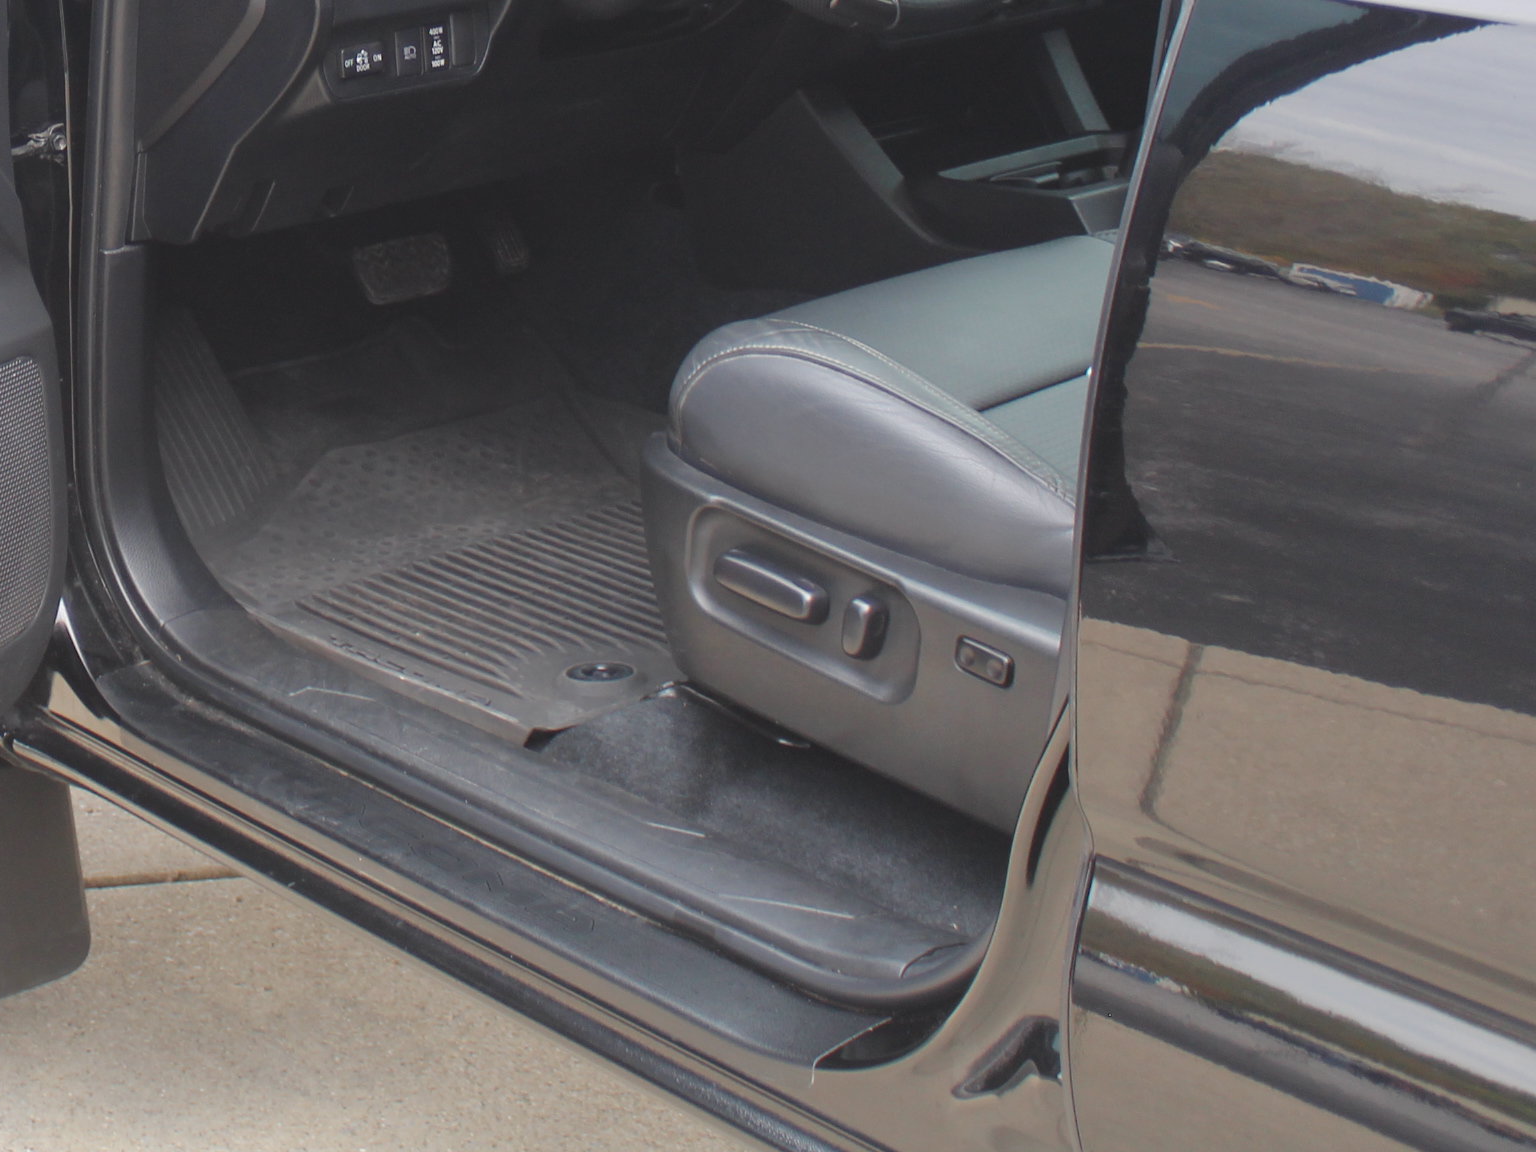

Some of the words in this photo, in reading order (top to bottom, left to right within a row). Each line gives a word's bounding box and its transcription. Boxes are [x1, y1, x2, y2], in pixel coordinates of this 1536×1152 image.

[373, 54, 382, 62] ON
[344, 58, 353, 68] OFF
[356, 63, 370, 72] DOOR
